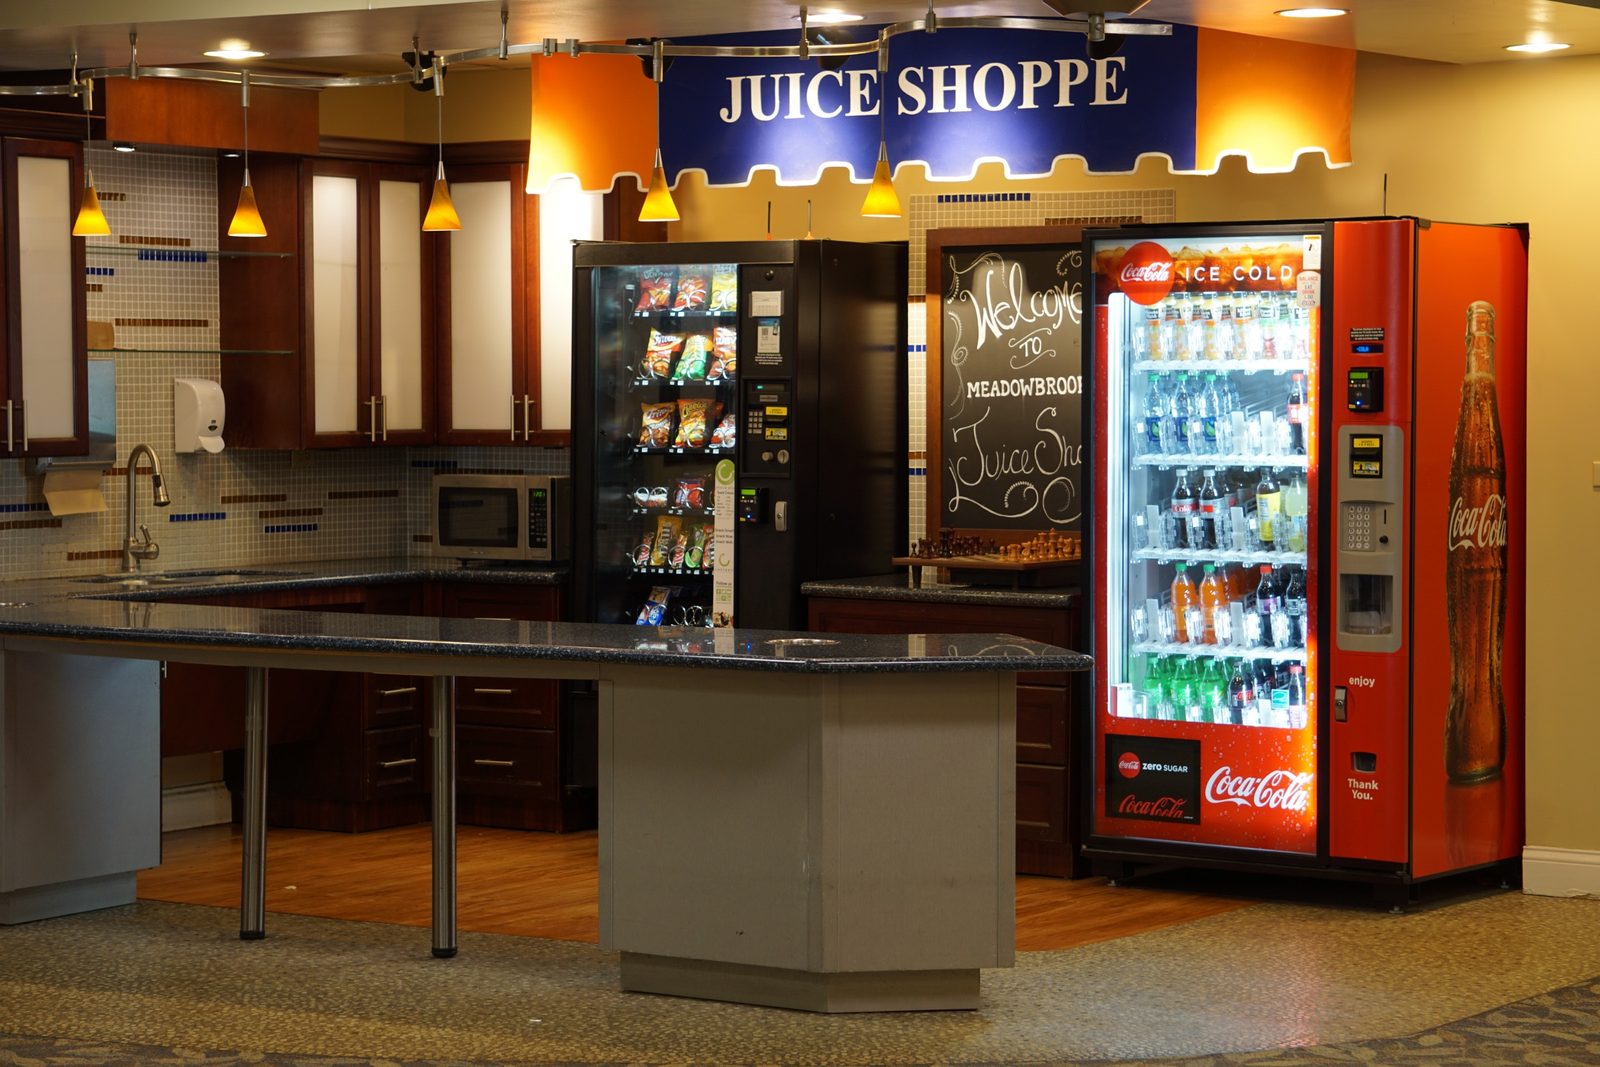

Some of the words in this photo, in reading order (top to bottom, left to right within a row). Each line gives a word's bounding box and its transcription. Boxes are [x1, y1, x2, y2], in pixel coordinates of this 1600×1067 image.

[720, 68, 880, 123] JUICE
[897, 56, 1128, 116] SHOPPE
[1120, 262, 1172, 282] Coca-Cola
[1185, 266, 1221, 282] ICE
[1232, 265, 1293, 281] COLD
[1019, 337, 1042, 357] TO
[1449, 494, 1507, 551] Coca-Cola
[1349, 676, 1375, 688] enjoy
[1142, 762, 1162, 771] zero
[1163, 764, 1188, 773] SUGAR
[1205, 765, 1314, 811] Coca-Cola
[1347, 778, 1378, 790] Thank
[1352, 789, 1373, 800] You.
